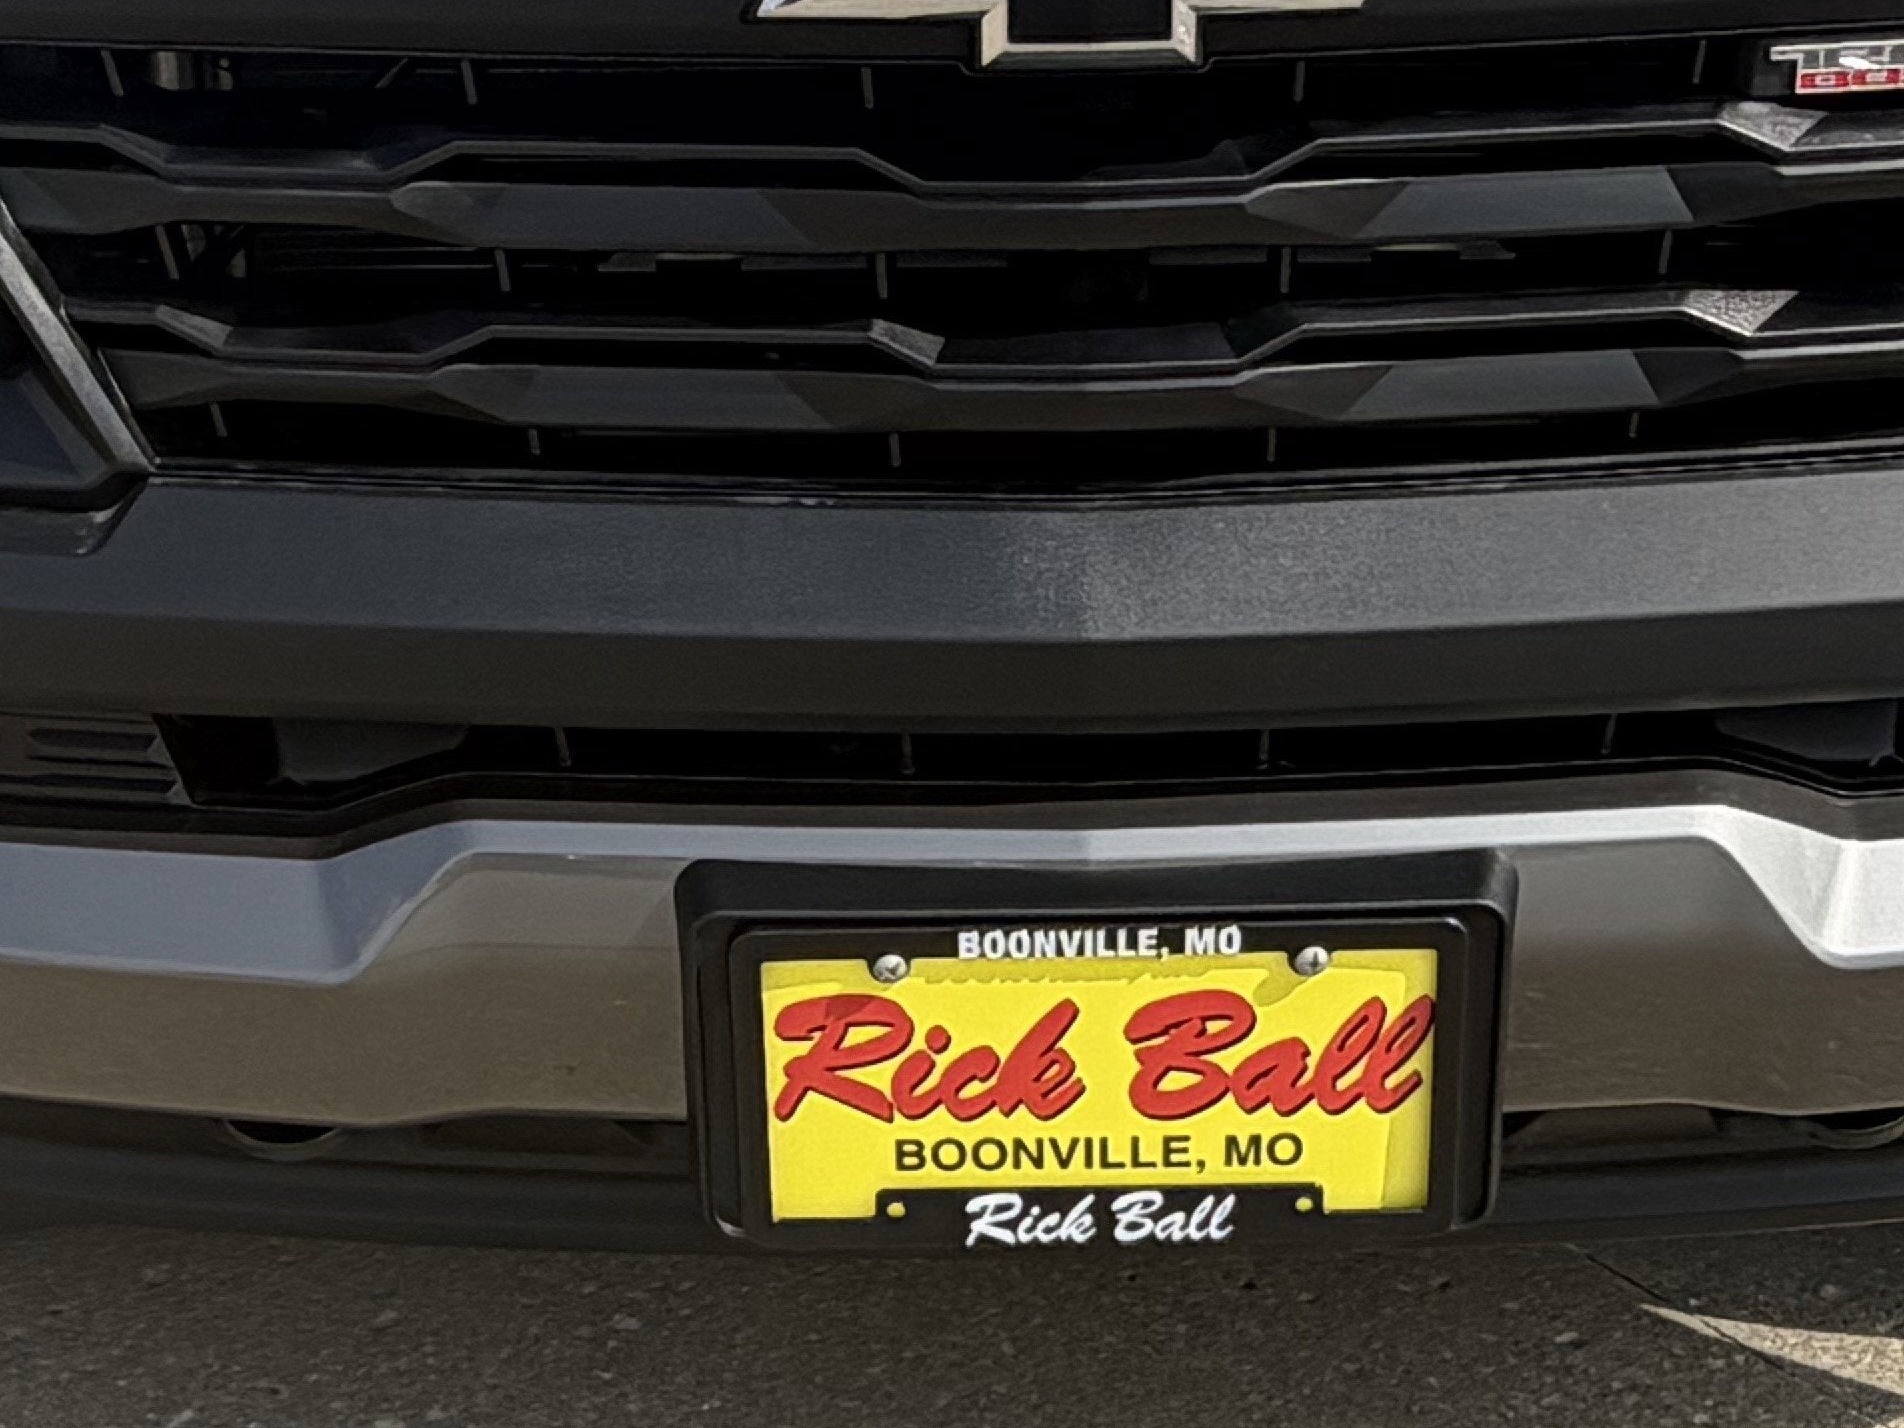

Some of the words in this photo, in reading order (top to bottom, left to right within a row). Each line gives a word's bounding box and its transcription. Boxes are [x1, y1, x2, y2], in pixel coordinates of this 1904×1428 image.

[957, 928, 1171, 962] BOONVILLE,
[1185, 925, 1243, 956] MO
[772, 993, 1086, 1123] Rick
[1122, 989, 1435, 1120] Ball
[893, 1135, 1208, 1174] BOONVILLE,
[1223, 1132, 1304, 1166] MO
[963, 1192, 1098, 1247] Rick
[1110, 1190, 1236, 1243] Ball
